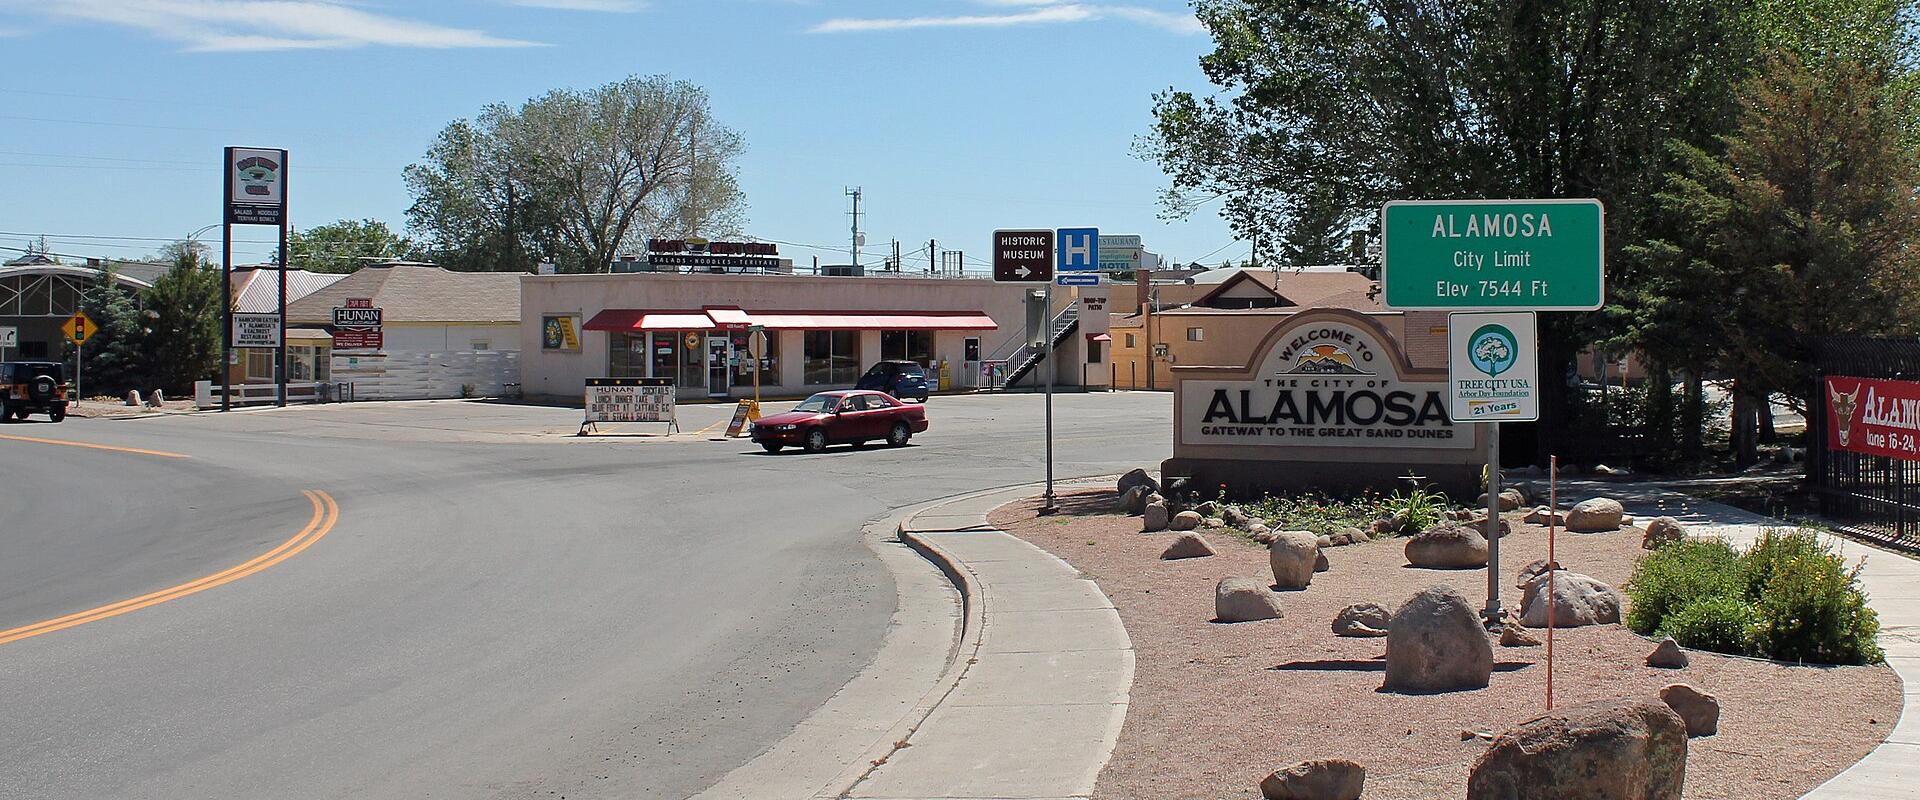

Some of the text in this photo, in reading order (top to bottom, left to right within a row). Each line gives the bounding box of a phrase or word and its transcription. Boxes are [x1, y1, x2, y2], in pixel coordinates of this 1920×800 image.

[1432, 213, 1552, 238] ALAMOSA
[1001, 236, 1046, 246] HISTORIC
[1101, 238, 1138, 246] STAURANT
[1003, 250, 1045, 259] MUSEUM
[1065, 234, 1090, 265] H
[1453, 250, 1531, 271] City Limit
[1436, 280, 1548, 297] Elev 7544 Ft
[337, 311, 379, 320] HUNAN
[1279, 328, 1374, 363] WELCOME TO
[1264, 379, 1390, 388] THE CITY OF
[1458, 379, 1529, 389] TREE CITY USA
[642, 387, 669, 395] COCKTAILS
[1478, 391, 1490, 399] Day
[1492, 390, 1530, 398] Foundation
[595, 395, 664, 403] LUNCH DINNER TAKE OUT
[592, 404, 605, 412] BLUE
[623, 404, 630, 412] AT
[634, 404, 659, 412] CATTAILS
[1201, 389, 1452, 427] ALAMOSA
[1474, 402, 1517, 415] 21 Years
[636, 413, 660, 421] SEAFOOD
[1201, 426, 1454, 439] GATEWAY TO THE GREAT SAND DUNES
